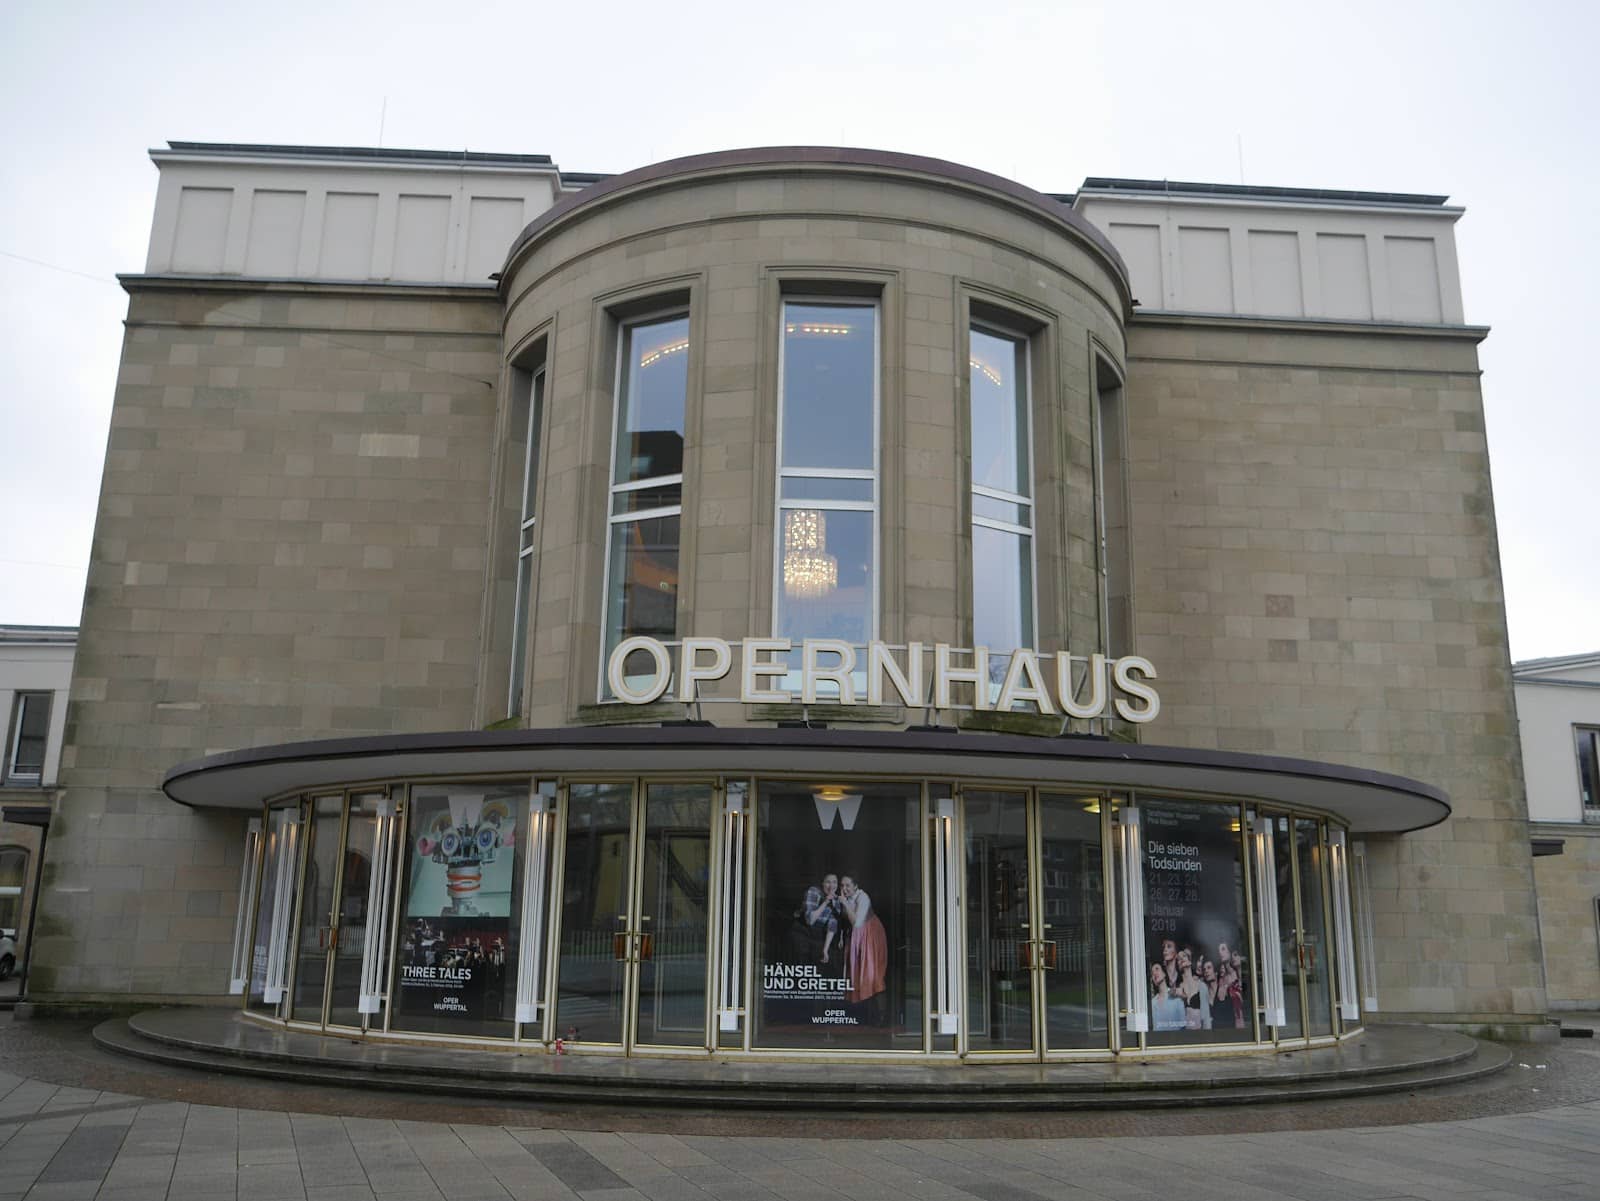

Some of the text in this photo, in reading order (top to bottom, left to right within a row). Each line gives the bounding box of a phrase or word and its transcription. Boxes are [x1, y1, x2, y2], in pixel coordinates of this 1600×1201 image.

[608, 636, 1161, 724] OPERNHAUS
[1148, 841, 1199, 857] Die sieben
[1148, 856, 1202, 871] Todsünden
[1151, 903, 1184, 917] Januar
[1152, 918, 1176, 932] 2018
[402, 966, 436, 979] THREE
[438, 967, 472, 981] TALES
[764, 962, 822, 978] HÄNSEL
[764, 978, 855, 991] UND GRETEL
[433, 1003, 468, 1012] WUPPERTAL
[824, 1009, 846, 1017] OPER
[811, 1017, 859, 1025] WUPPERTAL
